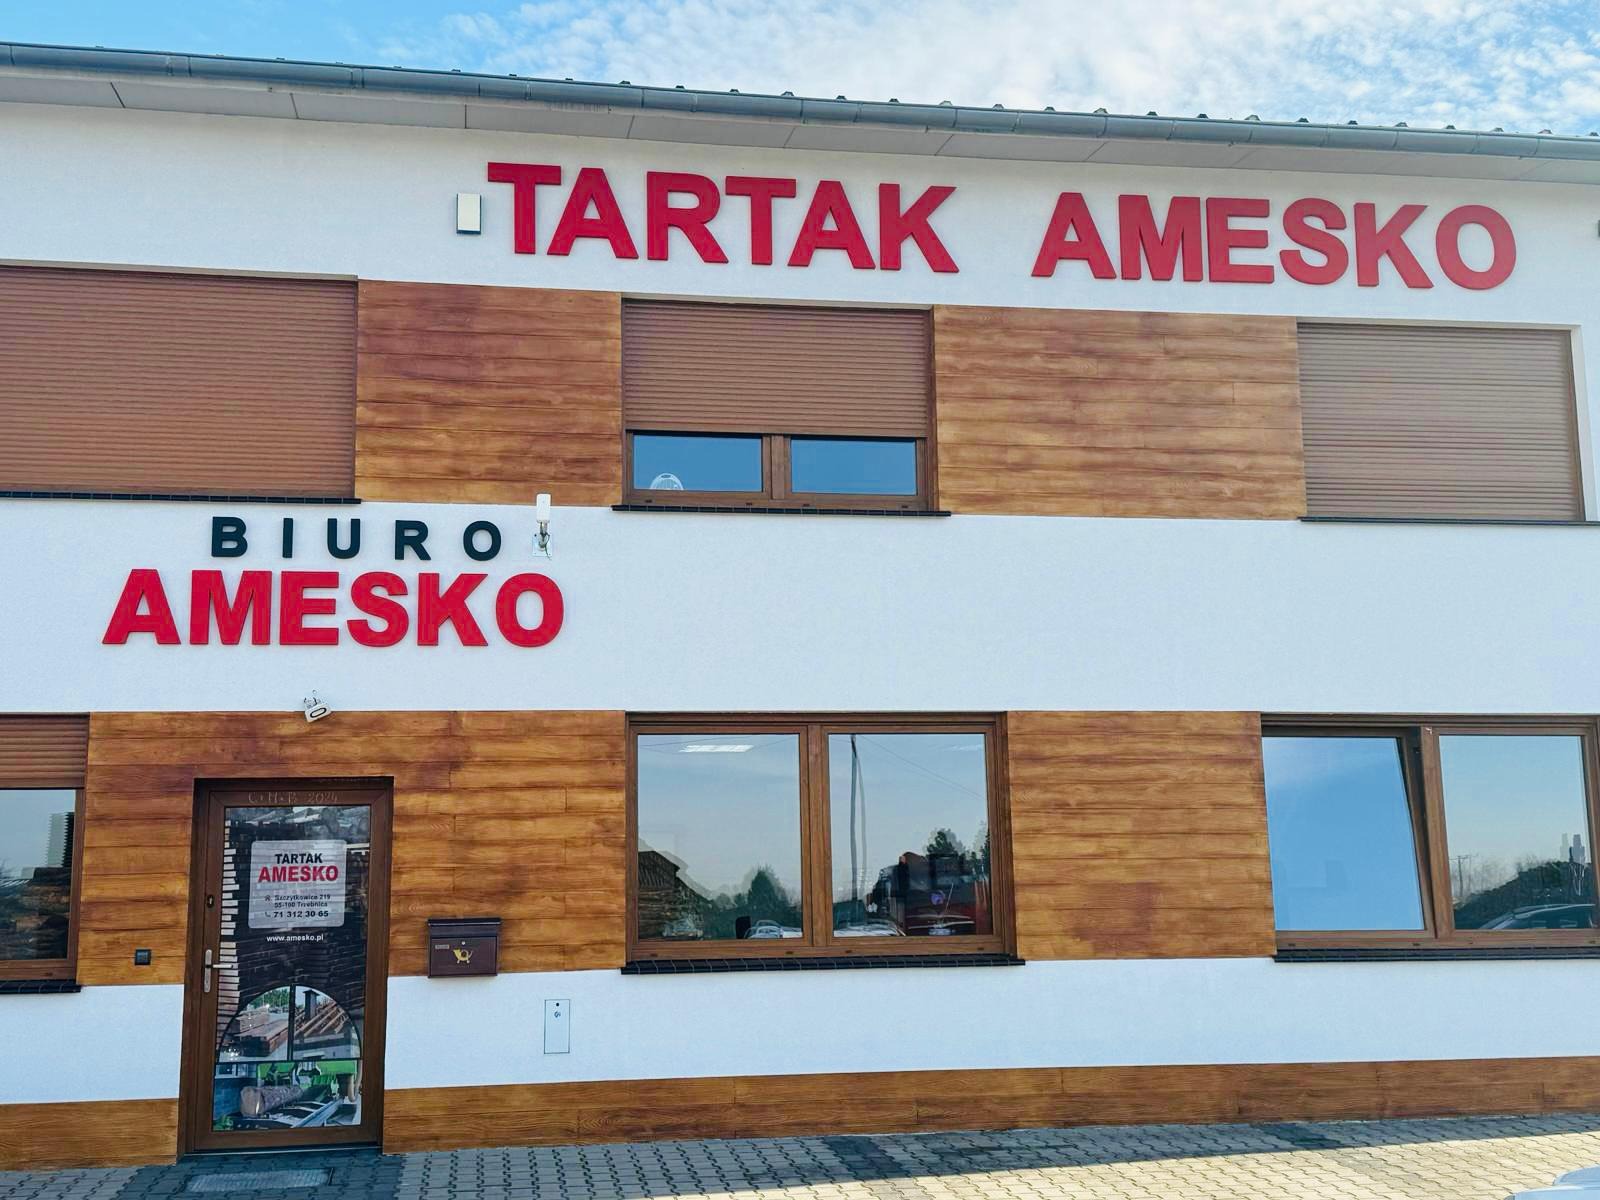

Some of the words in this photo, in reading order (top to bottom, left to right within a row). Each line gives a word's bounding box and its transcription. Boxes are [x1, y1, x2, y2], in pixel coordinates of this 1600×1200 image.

[488, 162, 960, 274] TARTAK
[1030, 191, 1518, 291] AMESKO
[210, 516, 502, 562] BIURO
[101, 568, 565, 648] AMESKO
[274, 853, 323, 865] TARTAK
[257, 865, 339, 883] AMESKO
[305, 910, 316, 918] 30
[318, 910, 329, 918] 65
[266, 934, 324, 943] www.amesko.pl
